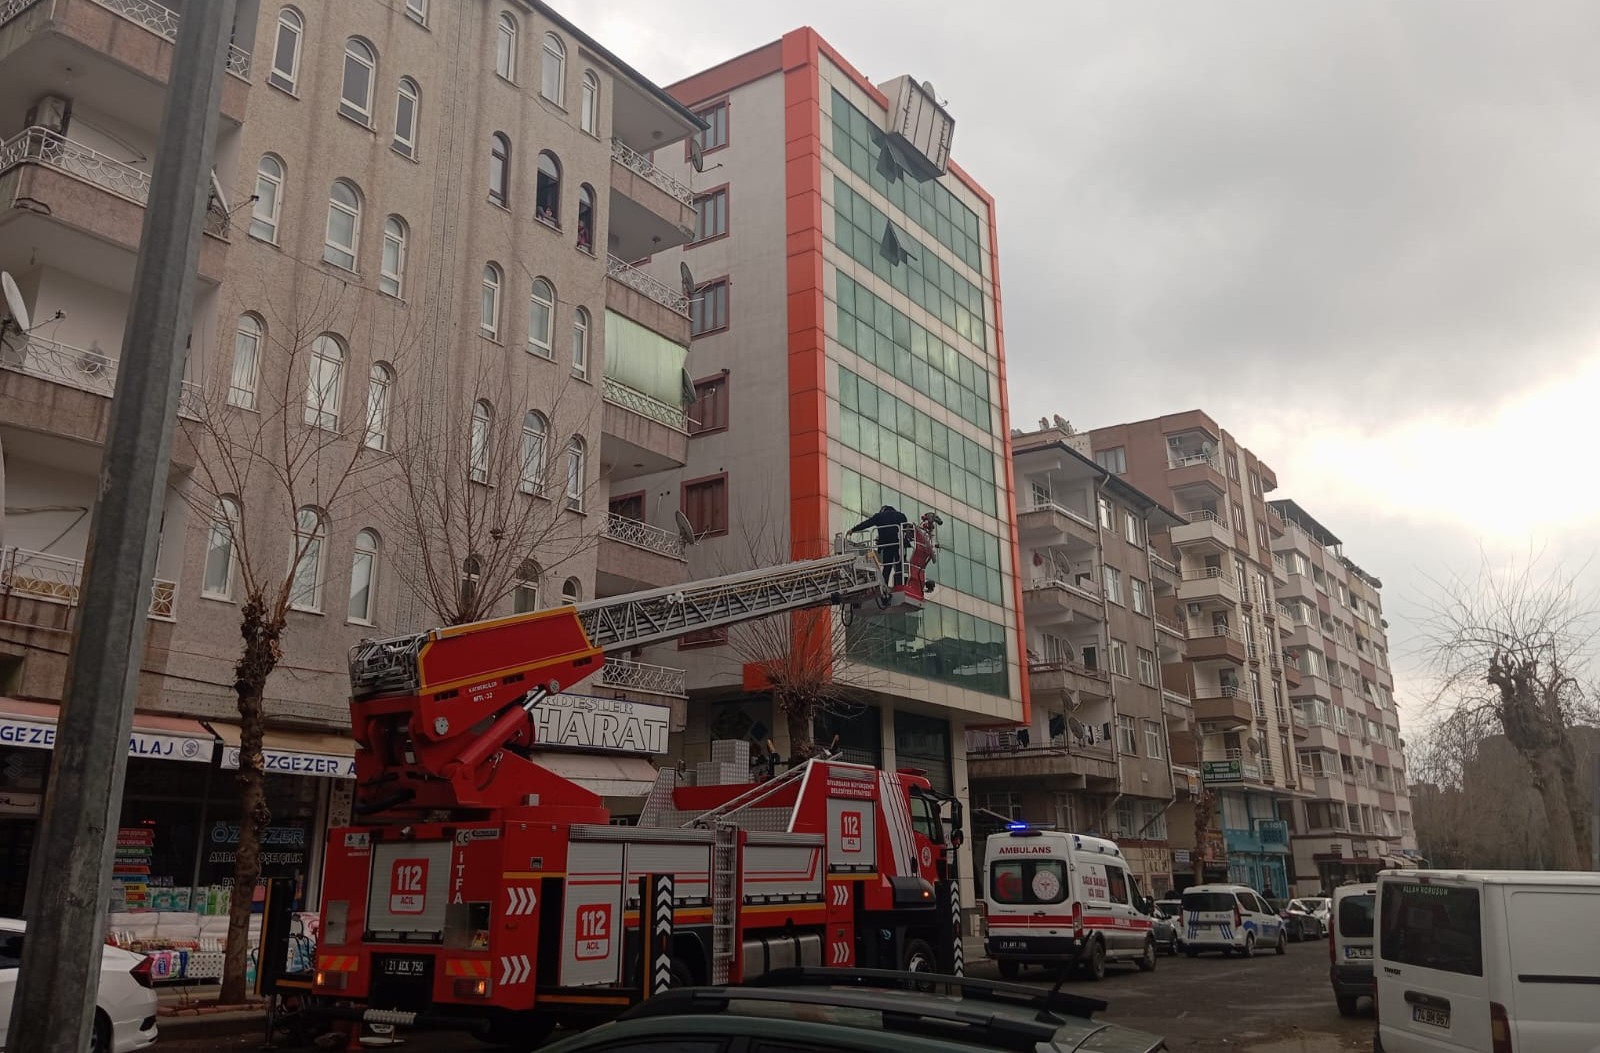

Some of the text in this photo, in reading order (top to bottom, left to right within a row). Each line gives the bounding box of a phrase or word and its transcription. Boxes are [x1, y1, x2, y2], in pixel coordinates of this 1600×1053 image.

[0, 725, 174, 756] GEZE ALAJ
[533, 707, 668, 752] HARAT
[266, 754, 338, 774] ZGEZER
[210, 820, 305, 845] ÖZEZER
[843, 816, 859, 835] 112
[999, 847, 1051, 855] AMBULANS
[397, 865, 422, 891] 112
[453, 850, 465, 905] İTFA
[581, 909, 606, 937] 112
